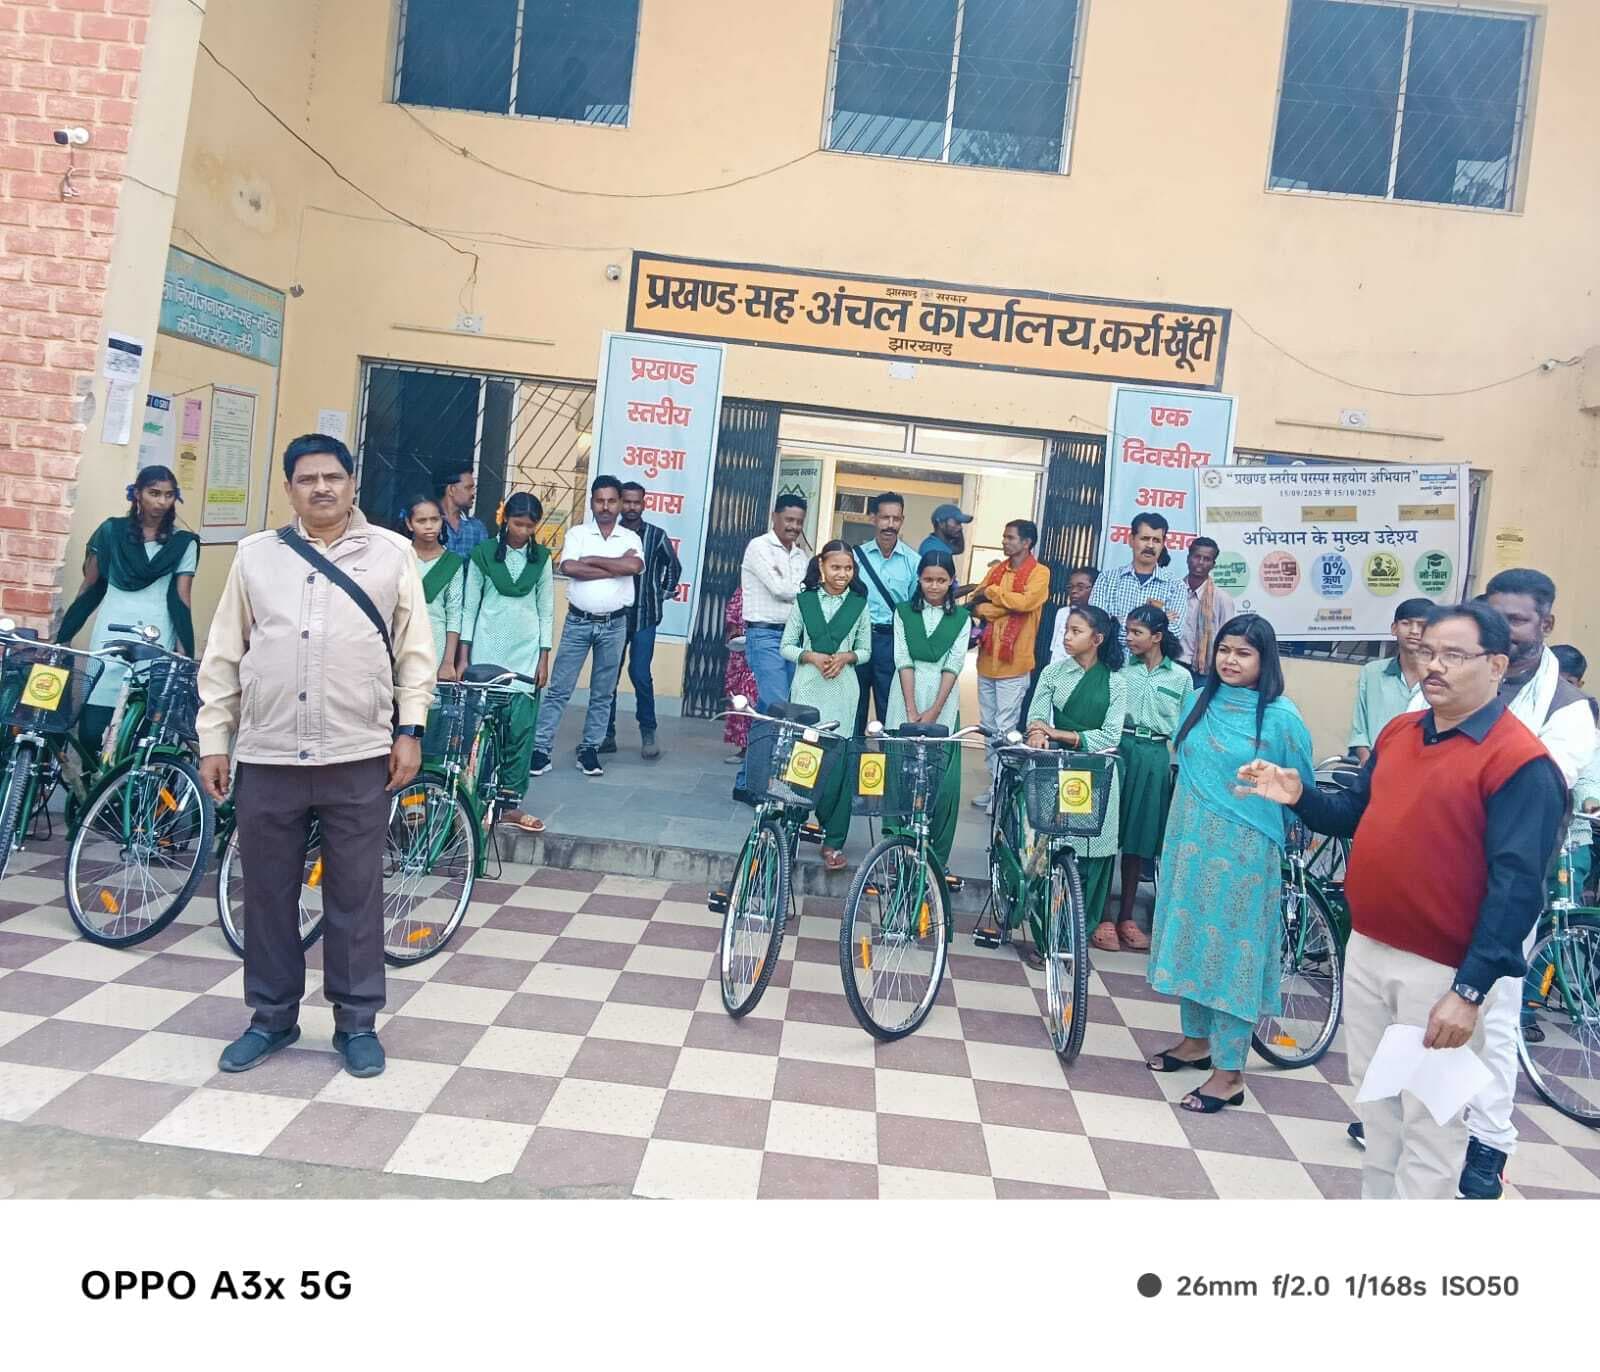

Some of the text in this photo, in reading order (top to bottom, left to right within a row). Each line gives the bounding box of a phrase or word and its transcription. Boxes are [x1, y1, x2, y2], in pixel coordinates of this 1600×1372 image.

[936, 293, 968, 304] सरकार
[888, 337, 953, 356] झारखण्ड
[631, 357, 698, 385] प्रखण्ड
[627, 396, 692, 427] स्तरीय
[1151, 406, 1192, 427] एक
[623, 446, 687, 478] अबुआ
[1122, 437, 1211, 469] दिवसीय
[1269, 469, 1298, 485] स्तरीय
[1332, 467, 1367, 485] सहयोग
[642, 489, 685, 514] वास
[1136, 488, 1187, 509] आम
[1243, 525, 1419, 552] अभियान के मुख्य उद्देश्य
[1323, 561, 1346, 575] 0%
[1322, 575, 1342, 585] ऋण
